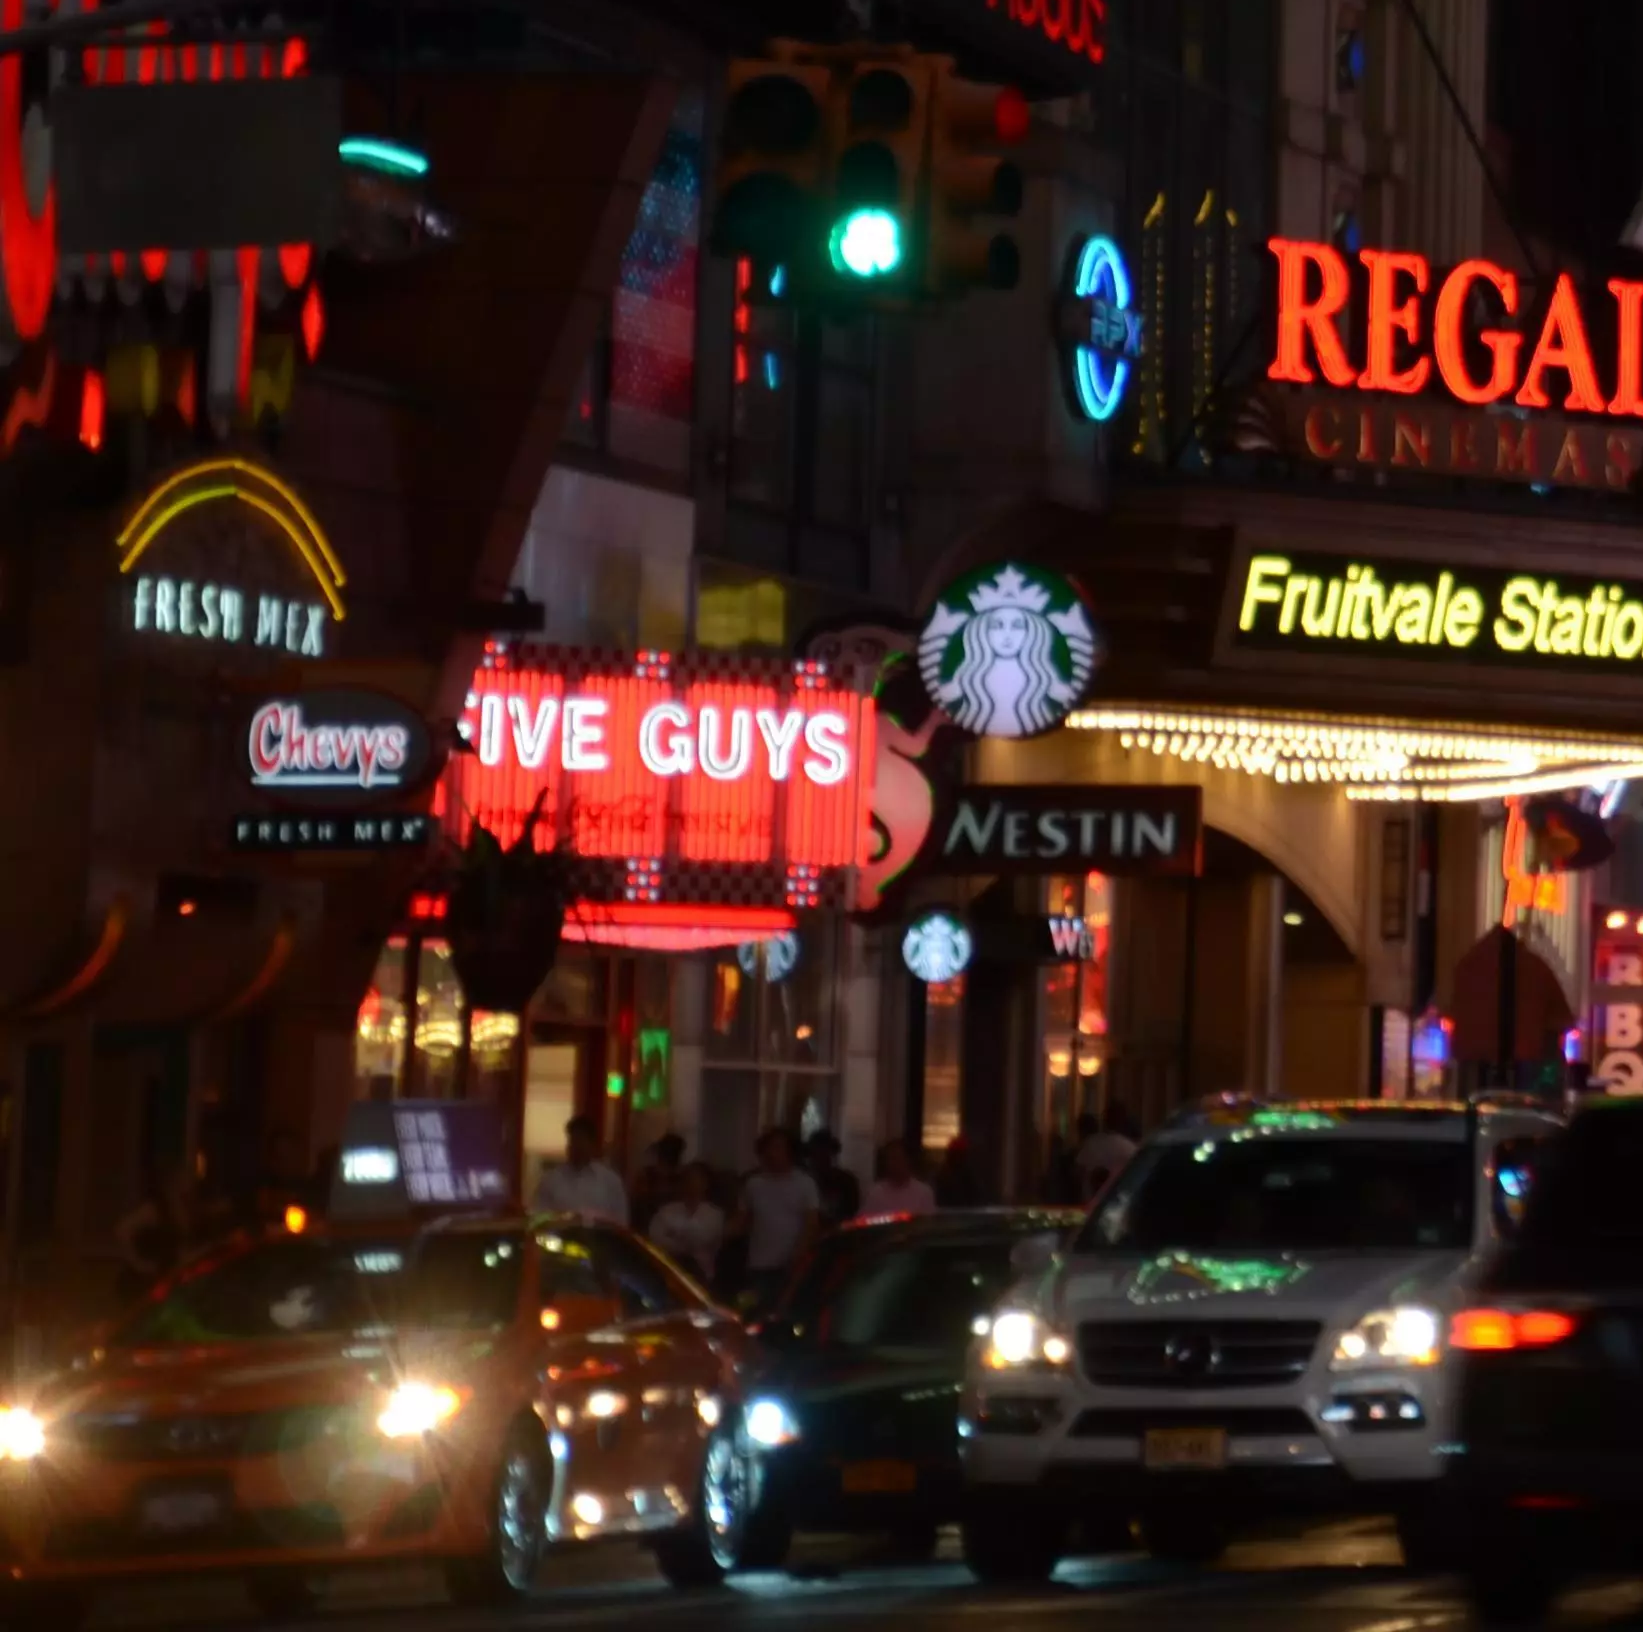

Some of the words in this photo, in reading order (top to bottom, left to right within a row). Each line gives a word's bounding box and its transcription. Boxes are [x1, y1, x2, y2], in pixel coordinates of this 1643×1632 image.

[1304, 404, 1632, 487] CINEMAS
[134, 579, 243, 642] FRESH
[253, 598, 325, 656] MEX
[1237, 554, 1482, 650] Fruitvale
[250, 700, 410, 790] Chevys
[464, 692, 608, 771] IVE
[638, 697, 851, 786] GUYS
[237, 818, 335, 842] FRESH
